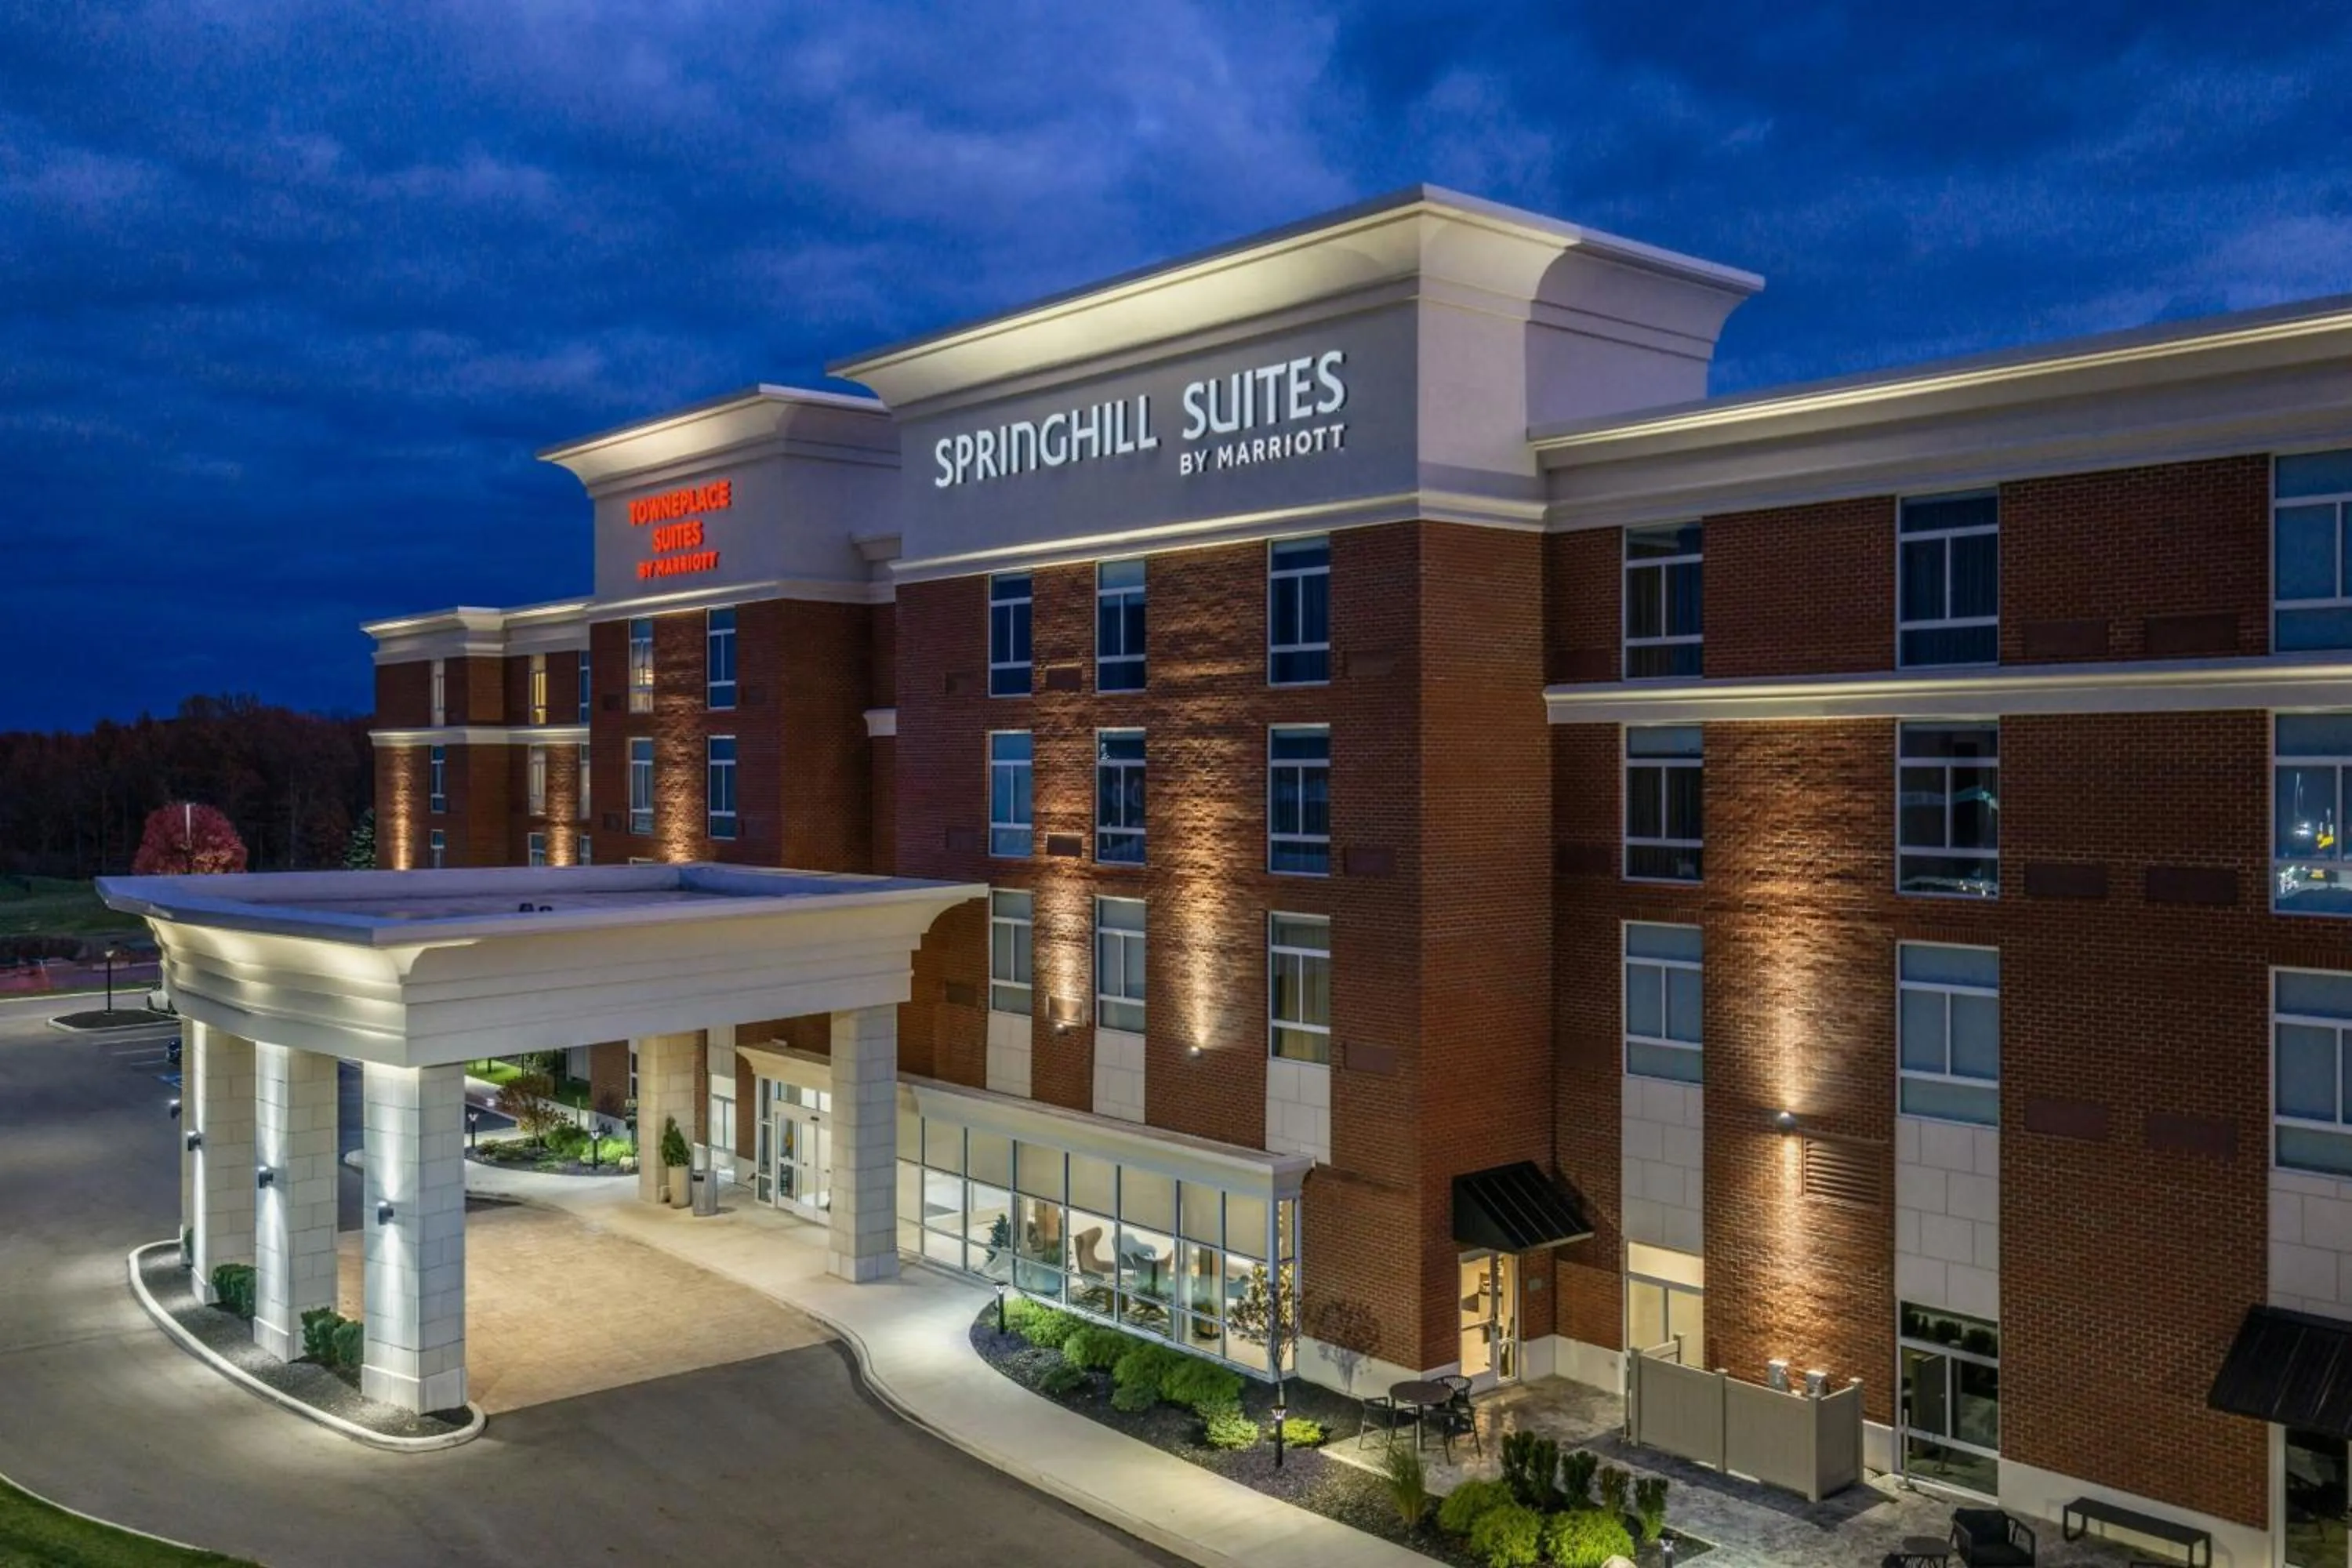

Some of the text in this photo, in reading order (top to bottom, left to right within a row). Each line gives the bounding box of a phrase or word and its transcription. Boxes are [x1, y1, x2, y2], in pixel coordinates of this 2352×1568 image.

[935, 350, 1346, 488] SPRINGHILL SUITES
[1180, 424, 1345, 476] BY MARRIOTT
[629, 480, 730, 526] TOWNEPLACE
[652, 521, 702, 553] SUITES
[637, 551, 719, 579] BY MARRIOTT
